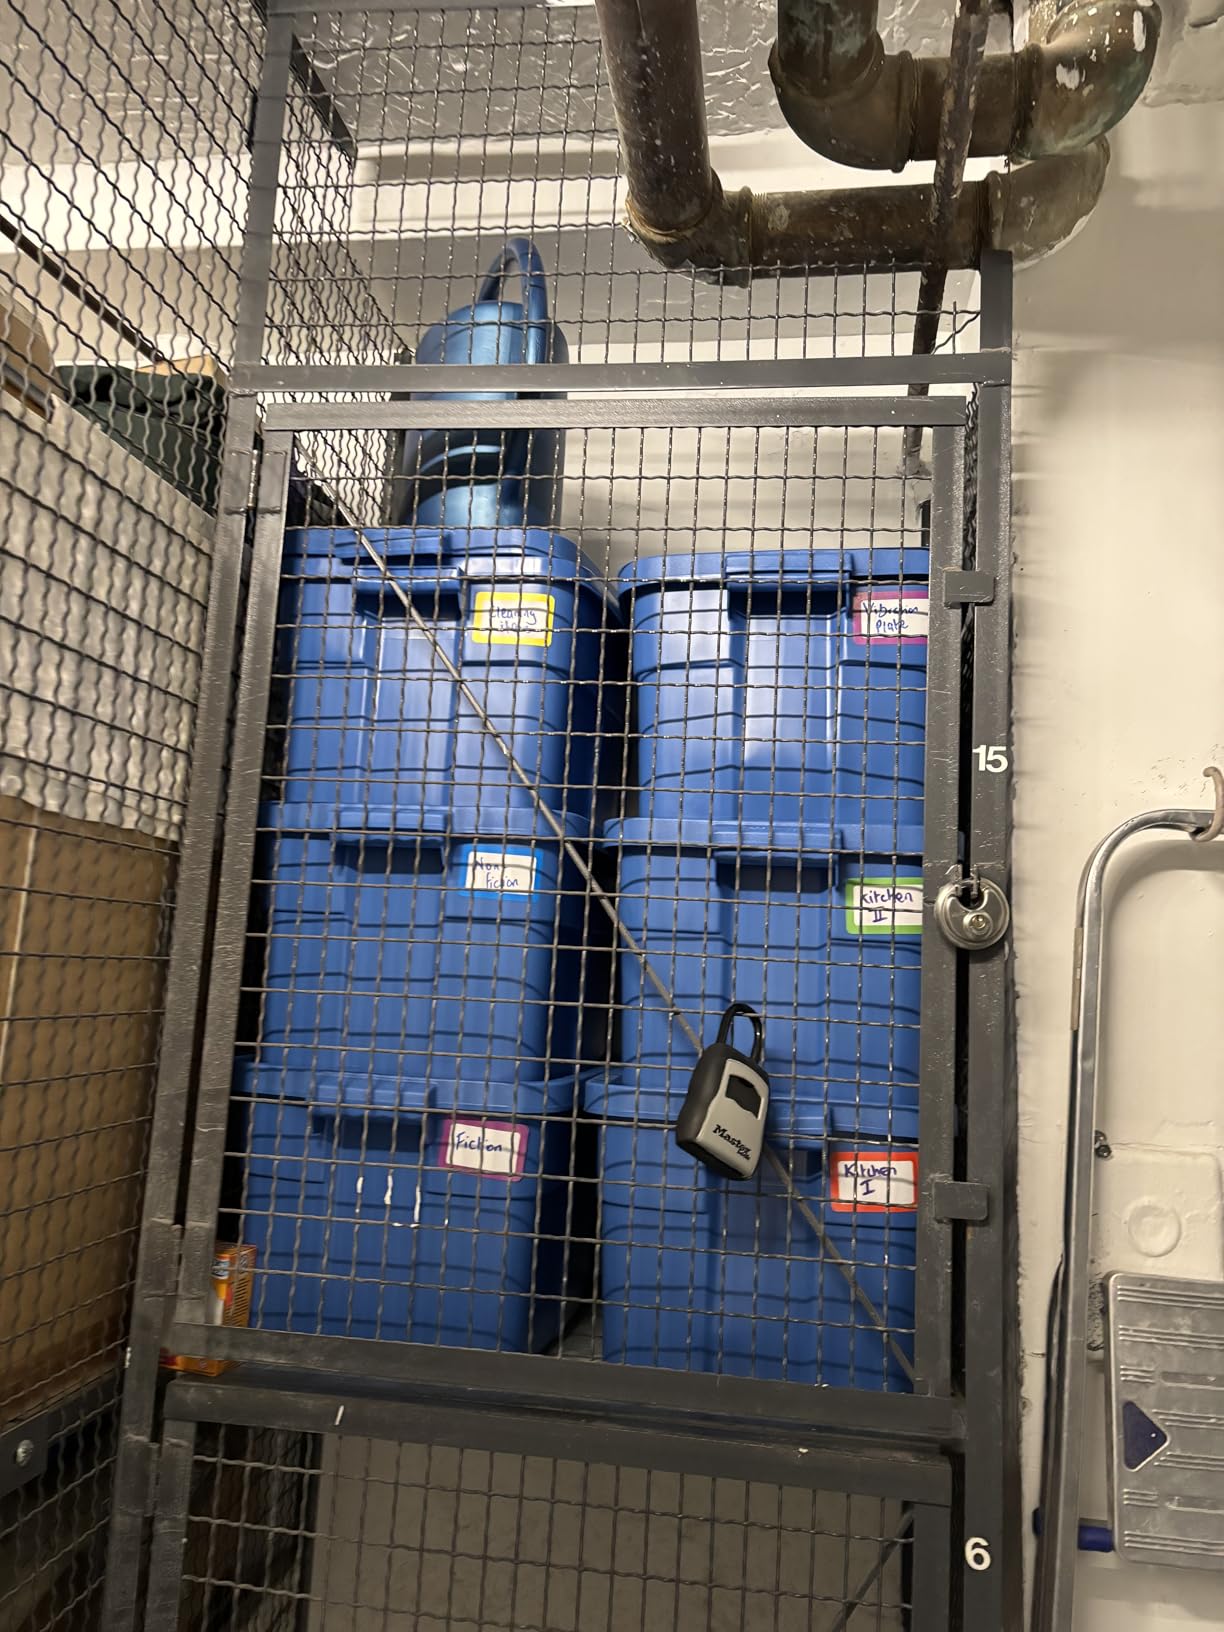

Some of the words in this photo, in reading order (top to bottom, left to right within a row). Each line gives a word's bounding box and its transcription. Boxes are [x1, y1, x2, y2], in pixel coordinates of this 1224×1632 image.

[972, 744, 1009, 773] 15
[869, 906, 888, 923] II
[712, 1124, 752, 1154] Master
[844, 1163, 897, 1178] Ktchen
[859, 1179, 876, 1196] I
[964, 1536, 992, 1571] 6
